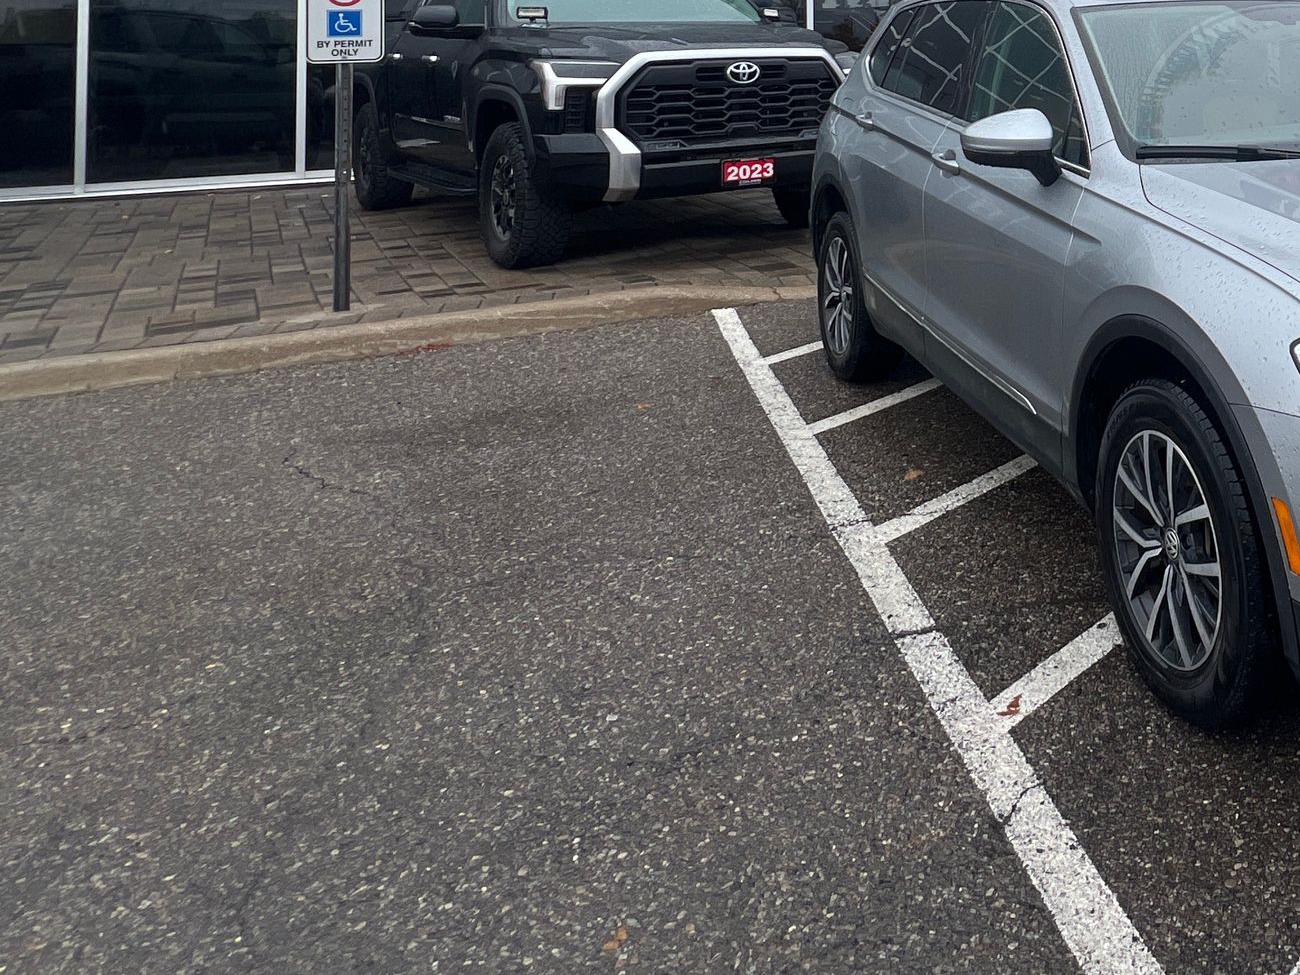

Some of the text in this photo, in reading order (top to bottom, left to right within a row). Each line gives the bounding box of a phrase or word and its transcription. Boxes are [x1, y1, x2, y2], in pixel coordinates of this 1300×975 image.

[316, 39, 373, 48] BY PERMIT
[331, 48, 359, 57] ONLY
[727, 163, 774, 181] 2023
